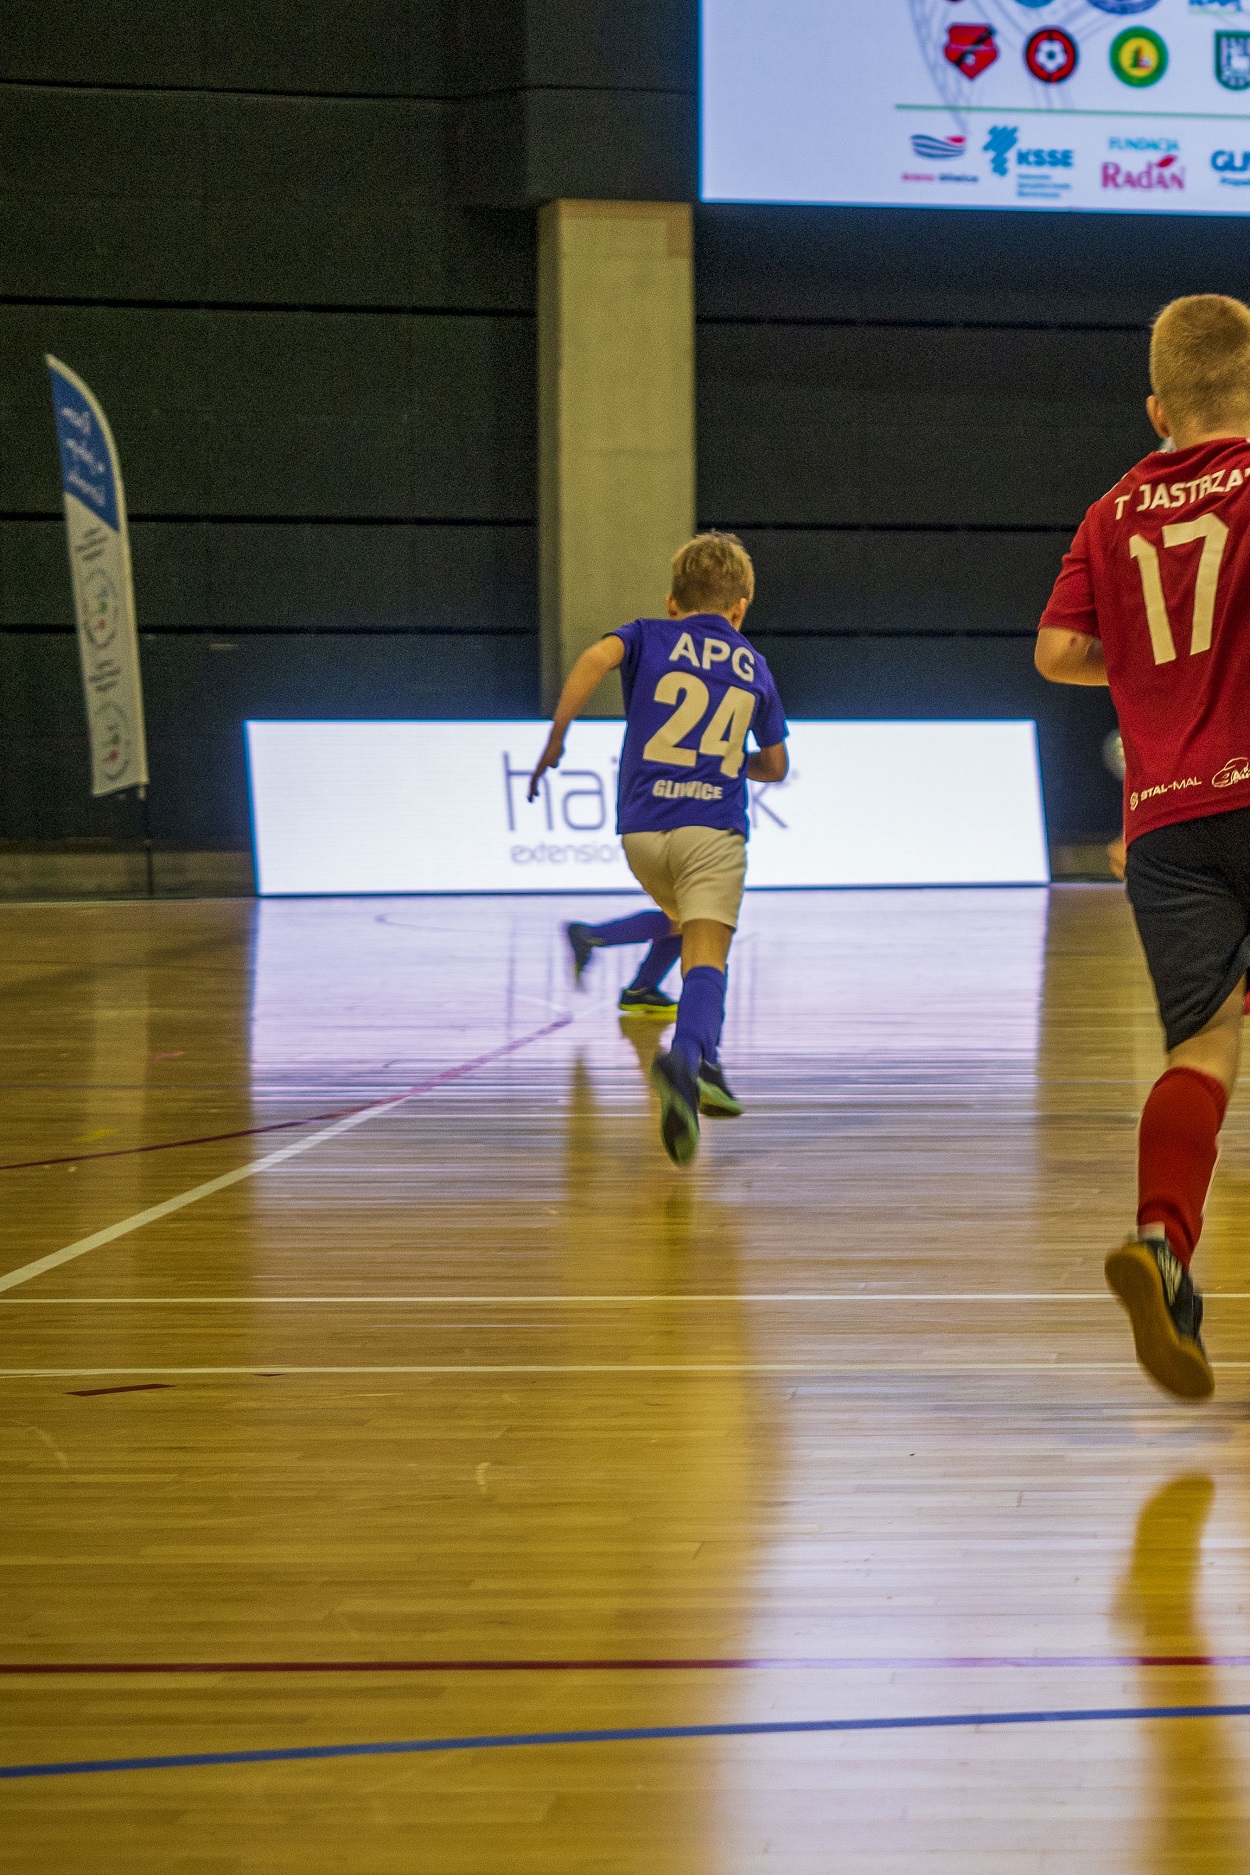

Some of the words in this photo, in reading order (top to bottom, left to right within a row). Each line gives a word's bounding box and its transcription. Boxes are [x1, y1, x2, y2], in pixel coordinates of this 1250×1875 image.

[1017, 150, 1073, 168] KSSE
[1128, 512, 1230, 666] 17
[669, 632, 755, 682] APG
[643, 671, 756, 779] 24
[652, 779, 723, 800] GLIWICE
[1140, 776, 1202, 801] STAL-MAL
